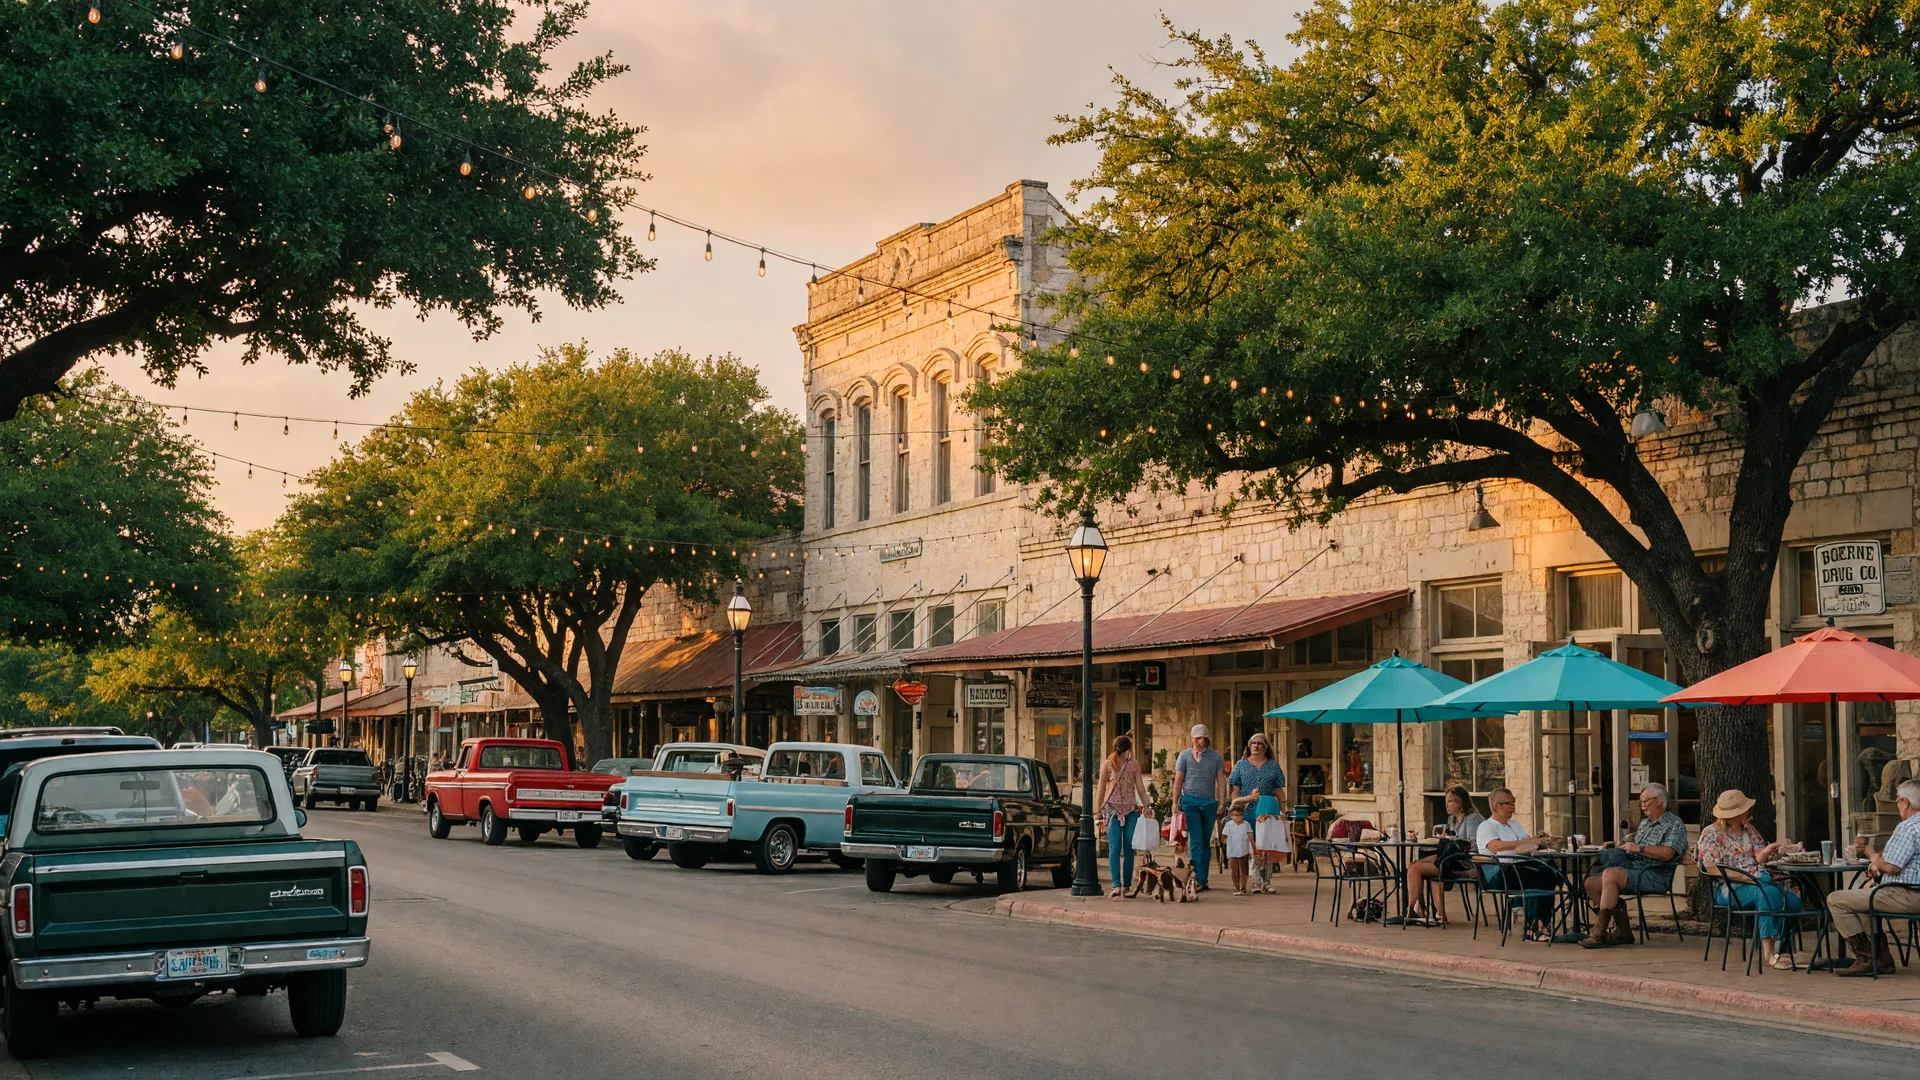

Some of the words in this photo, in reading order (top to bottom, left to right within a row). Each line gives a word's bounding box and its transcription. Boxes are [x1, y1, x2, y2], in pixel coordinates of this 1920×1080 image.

[1821, 546, 1874, 565] BOERNE
[1822, 567, 1853, 583] DRUG
[1860, 566, 1878, 581] CO.
